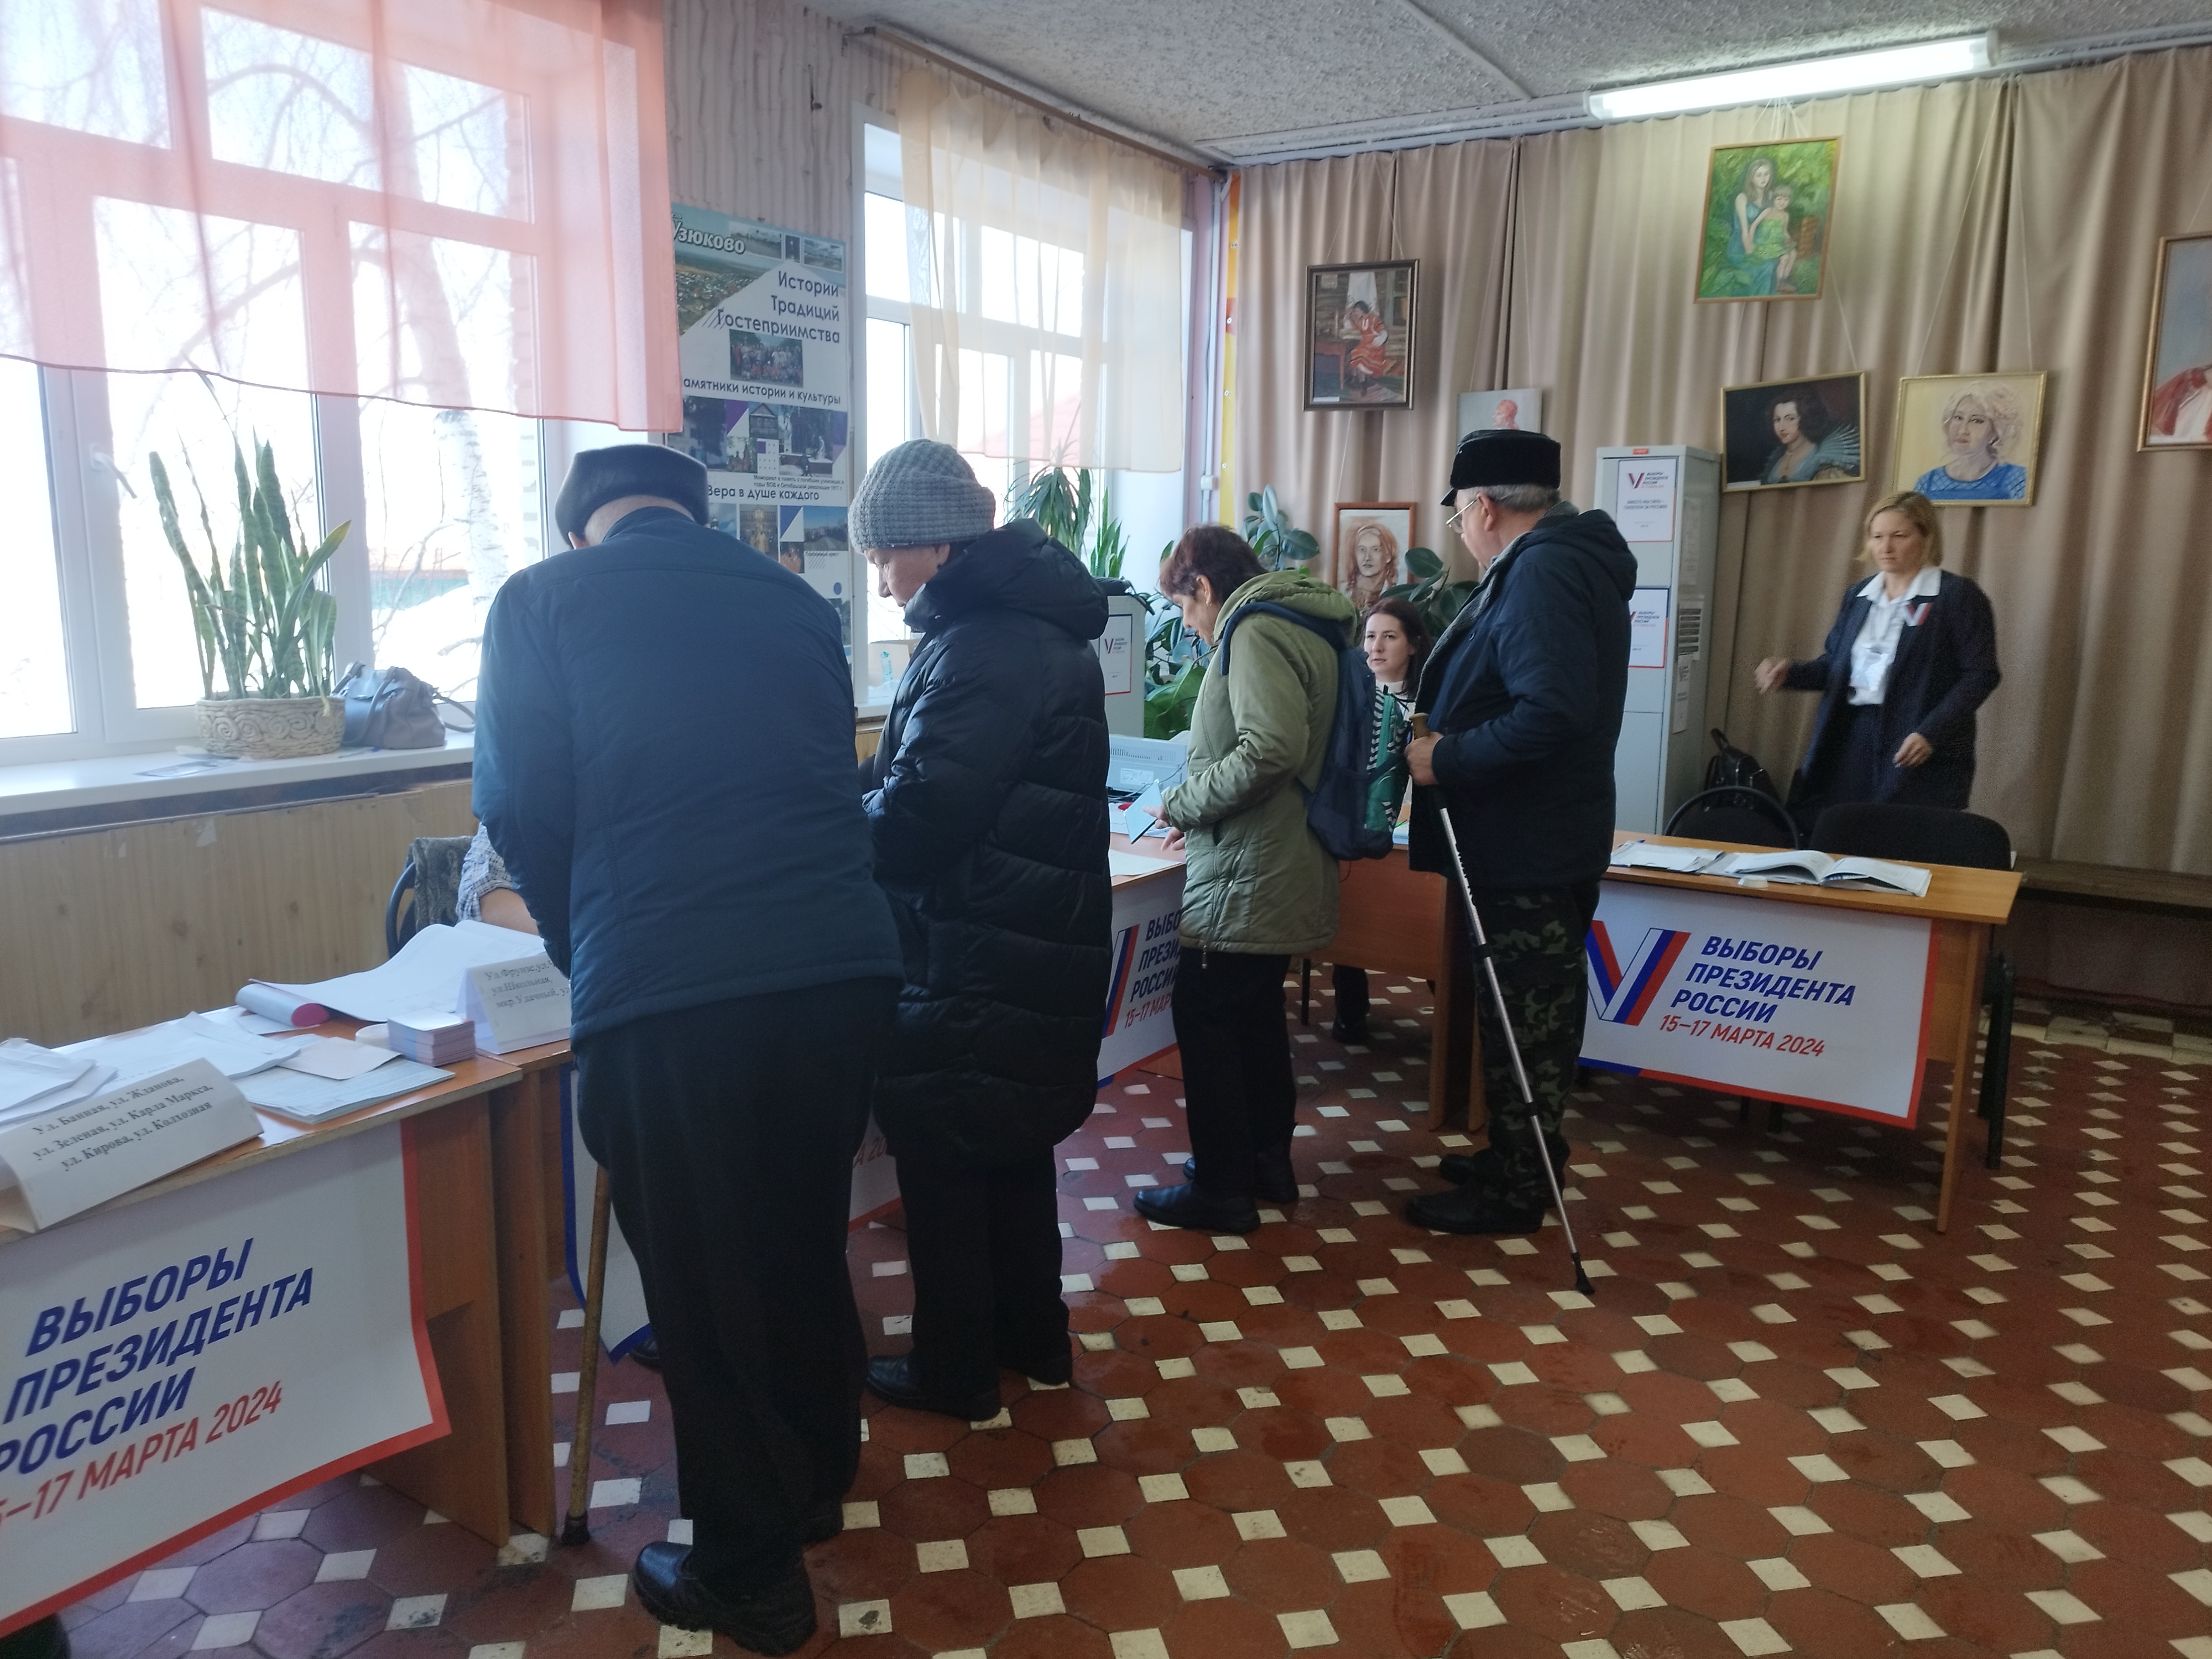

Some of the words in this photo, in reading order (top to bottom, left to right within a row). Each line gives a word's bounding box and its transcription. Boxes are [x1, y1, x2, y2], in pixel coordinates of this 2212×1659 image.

[779, 270, 839, 297] Истории
[771, 295, 839, 322] Традиций
[717, 308, 840, 344] Гостеприимства
[683, 378, 738, 393] амятники
[743, 384, 785, 399] истории
[789, 390, 794, 399] и
[797, 391, 841, 406] культуры
[739, 488, 744, 497] в
[748, 489, 776, 500] душе
[780, 490, 819, 501] каждого
[1145, 910, 1182, 942] ВЫБО
[1700, 935, 1823, 971] ВЫБОРЫ
[1684, 962, 1856, 1006] ПРЕЗИДЕНТА
[1149, 992, 1172, 1018] МАР
[1670, 989, 1779, 1024] РОССИИ
[1710, 1023, 1775, 1050] МАРТА
[1776, 1034, 1826, 1057] 2024
[127, 1100, 167, 1120] Карла
[152, 1100, 213, 1131] Колхозная
[25, 1237, 254, 1358] ВЫБОРЫ
[2, 1267, 314, 1425] ПРЕЗИДЕНТА
[0, 1366, 196, 1475] РОССИИ
[76, 1416, 200, 1501] МАРТА
[205, 1379, 283, 1444] 2024
